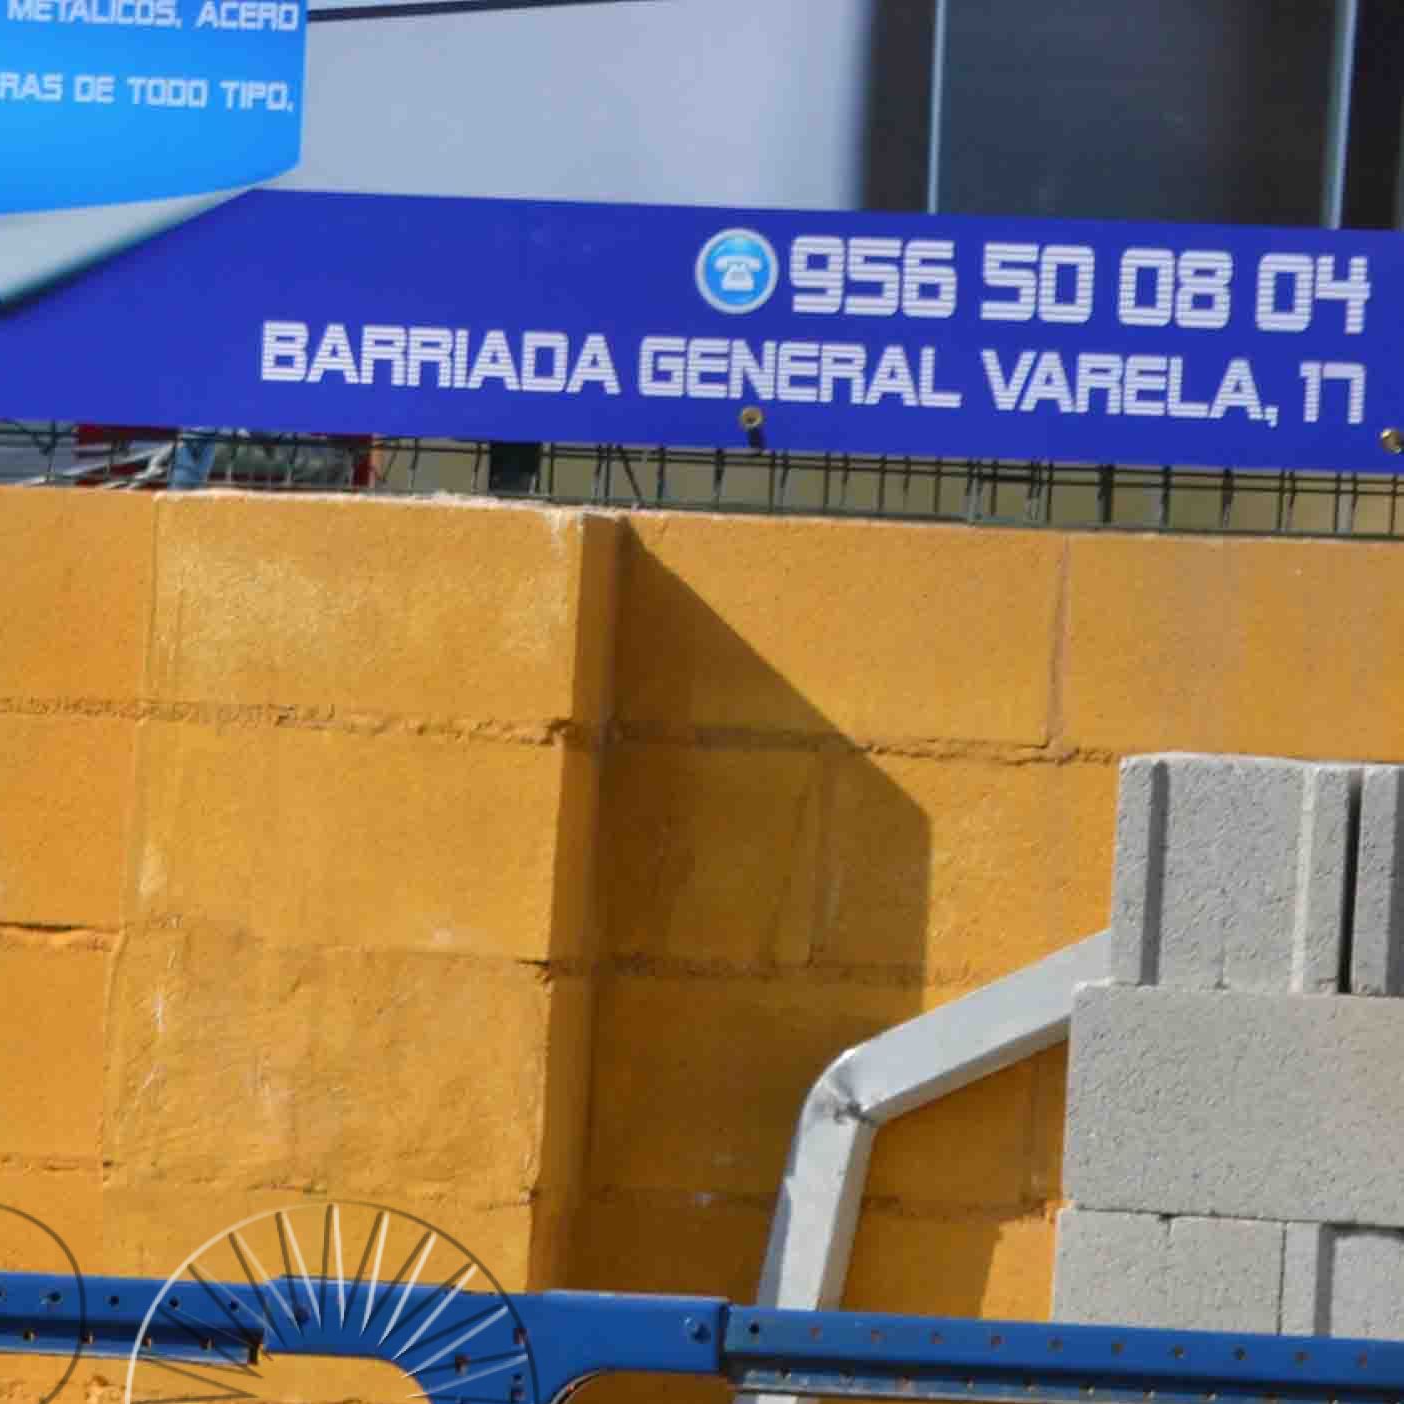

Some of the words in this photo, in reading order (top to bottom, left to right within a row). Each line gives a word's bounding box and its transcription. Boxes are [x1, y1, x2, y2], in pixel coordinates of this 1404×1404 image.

[194, 0, 299, 30] ACERO
[73, 74, 115, 103] DE
[127, 77, 208, 108] TODO
[790, 235, 957, 318] 956
[980, 242, 1094, 324] 50
[1118, 247, 1233, 329] 08
[1255, 253, 1371, 334] 04
[261, 321, 620, 394] BARRIADA
[638, 335, 961, 408] GENERAL
[981, 349, 1278, 427] VARELA,
[1300, 362, 1366, 424] 17
